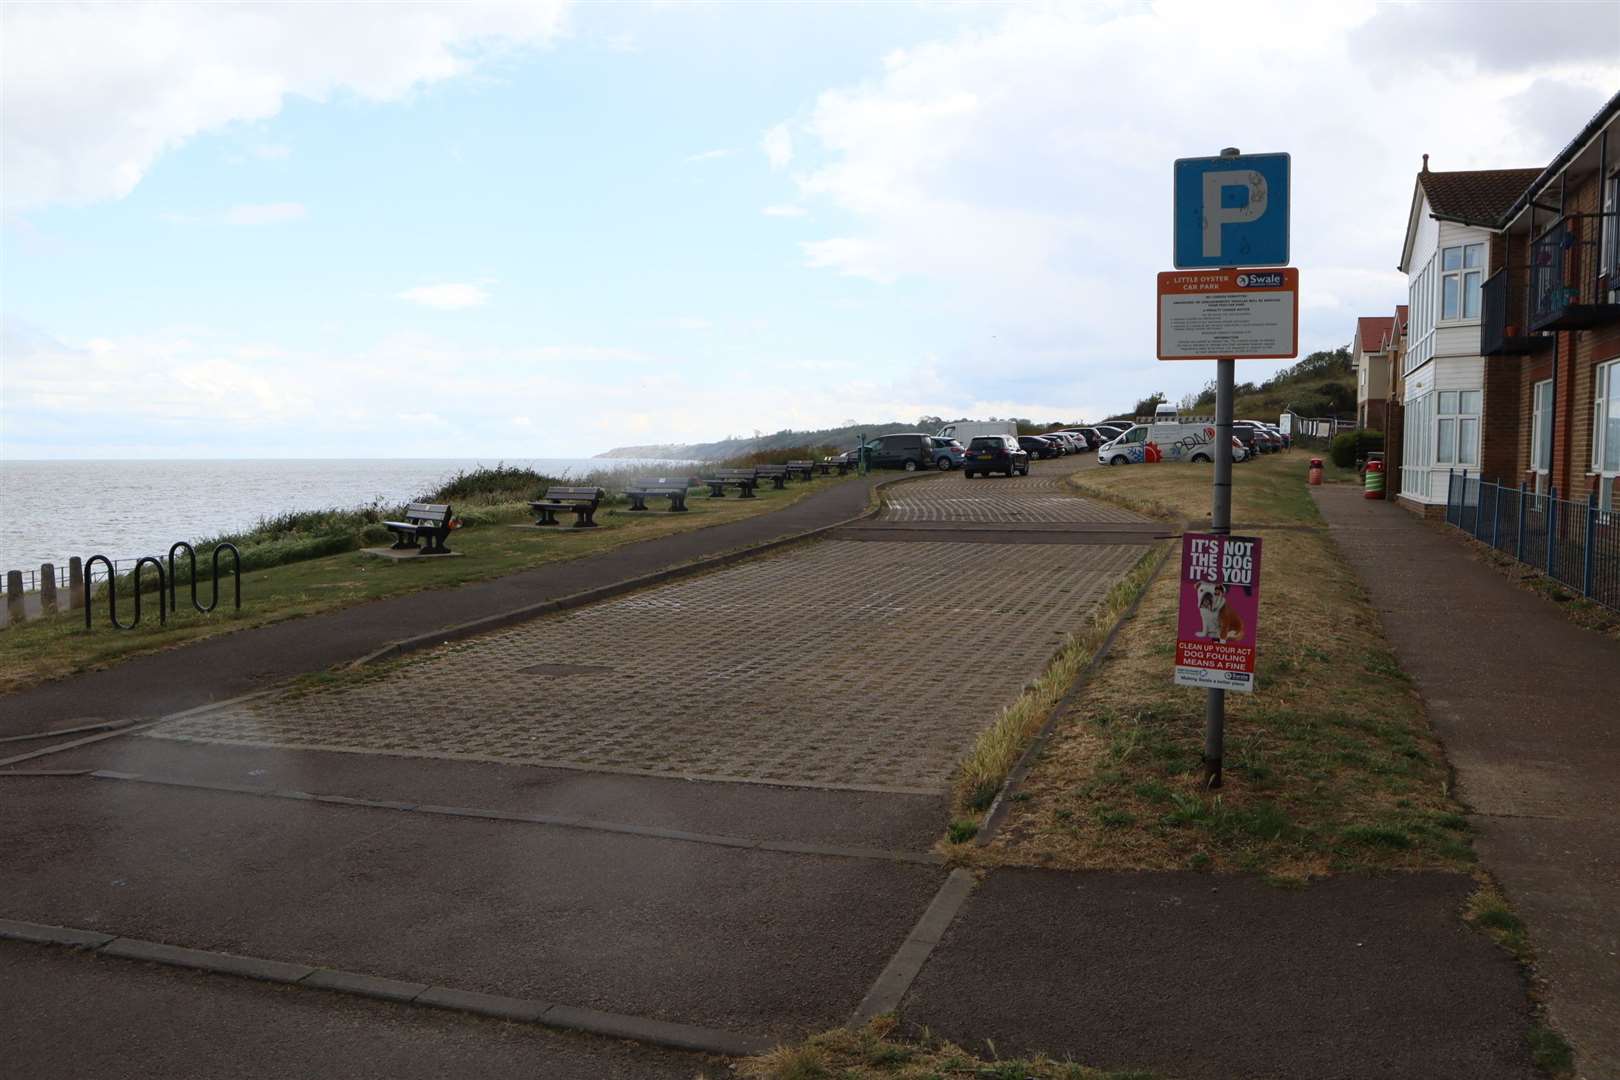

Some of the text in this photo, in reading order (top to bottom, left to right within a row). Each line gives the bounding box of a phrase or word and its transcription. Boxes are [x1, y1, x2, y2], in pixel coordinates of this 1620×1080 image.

[1203, 170, 1268, 257] P
[1250, 274, 1281, 284] Swale
[1191, 539, 1254, 556] IT'S NOT
[1190, 553, 1253, 570] THE DOG
[1189, 566, 1252, 583] IT'S YOU
[1179, 642, 1202, 651] CLEAN
[1215, 645, 1236, 654] YOUR
[1183, 658, 1215, 667] MEANS
[1217, 661, 1224, 669] A
[1184, 650, 1246, 663] DOG FOULING
